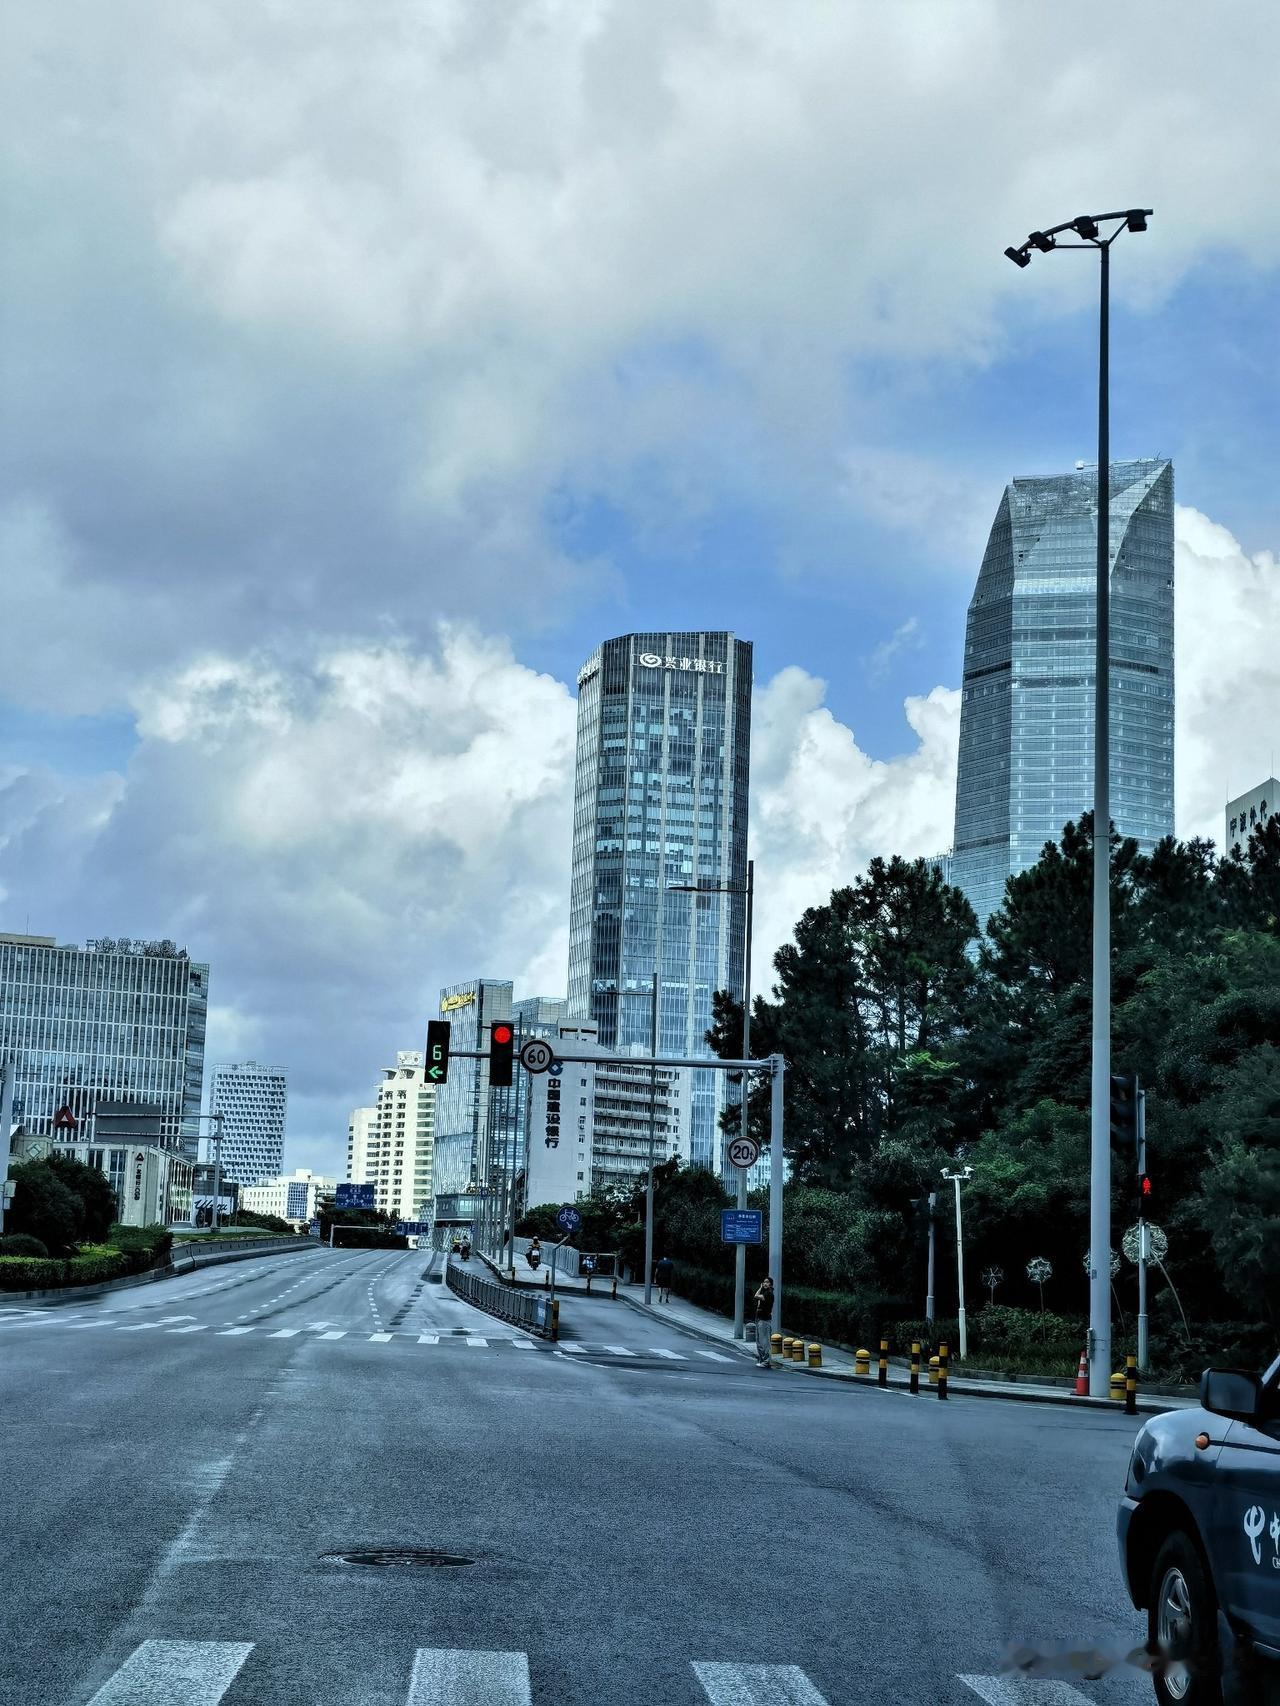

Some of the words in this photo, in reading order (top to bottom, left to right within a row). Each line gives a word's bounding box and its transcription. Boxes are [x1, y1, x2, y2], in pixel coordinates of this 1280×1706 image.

[664, 656, 723, 674] 兴业银行
[432, 1045, 442, 1061] 6
[527, 1048, 546, 1064] 60
[544, 1078, 561, 1149] 中国建设银行
